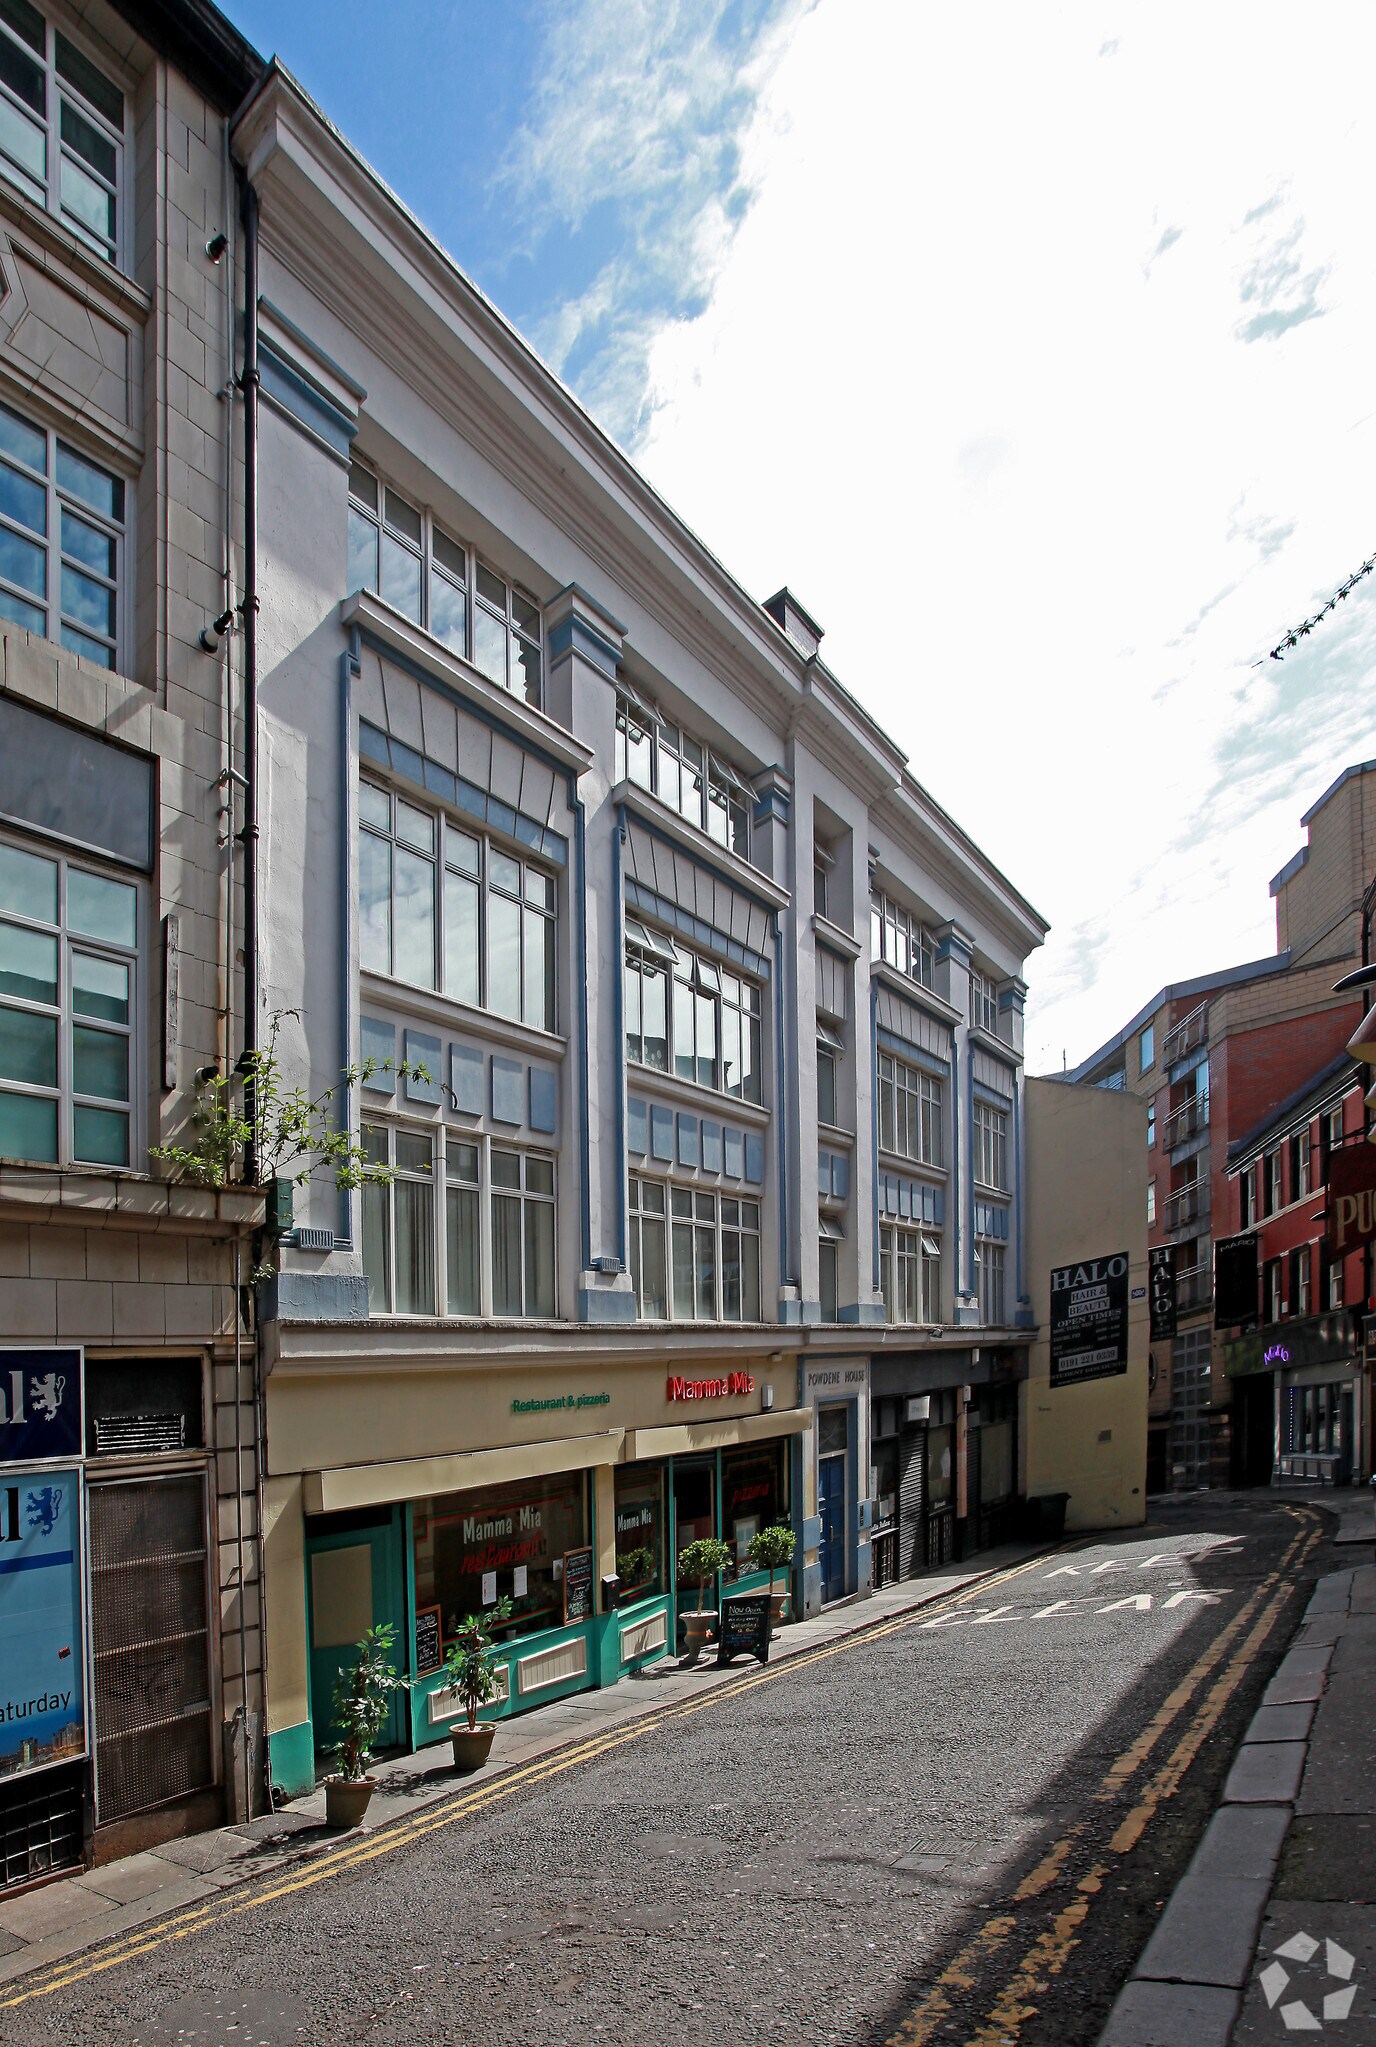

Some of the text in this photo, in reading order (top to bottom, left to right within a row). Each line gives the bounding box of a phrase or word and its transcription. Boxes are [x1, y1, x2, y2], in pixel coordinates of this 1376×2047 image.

[1335, 1189, 1376, 1249] PU
[1052, 1256, 1127, 1292] HALO
[1152, 1249, 1172, 1313] HALO
[1069, 1299, 1109, 1315] BEAUTY
[1072, 1285, 1107, 1302] HAIR &
[1057, 1315, 1087, 1328] OPEN
[1088, 1308, 1122, 1321] TIMES
[808, 1369, 865, 1386] POWDENE HOUSE
[1060, 1357, 1078, 1370] 0191
[669, 1371, 755, 1401] Mamma Mia
[513, 1392, 610, 1412] Restaurant & pizzeria
[463, 1505, 542, 1544] Mamma Mia
[617, 1507, 652, 1532] Mamma Mia
[461, 1532, 542, 1574] restaurant
[1042, 1546, 1245, 1579] KEEP
[918, 1589, 1235, 1628] CLEAR
